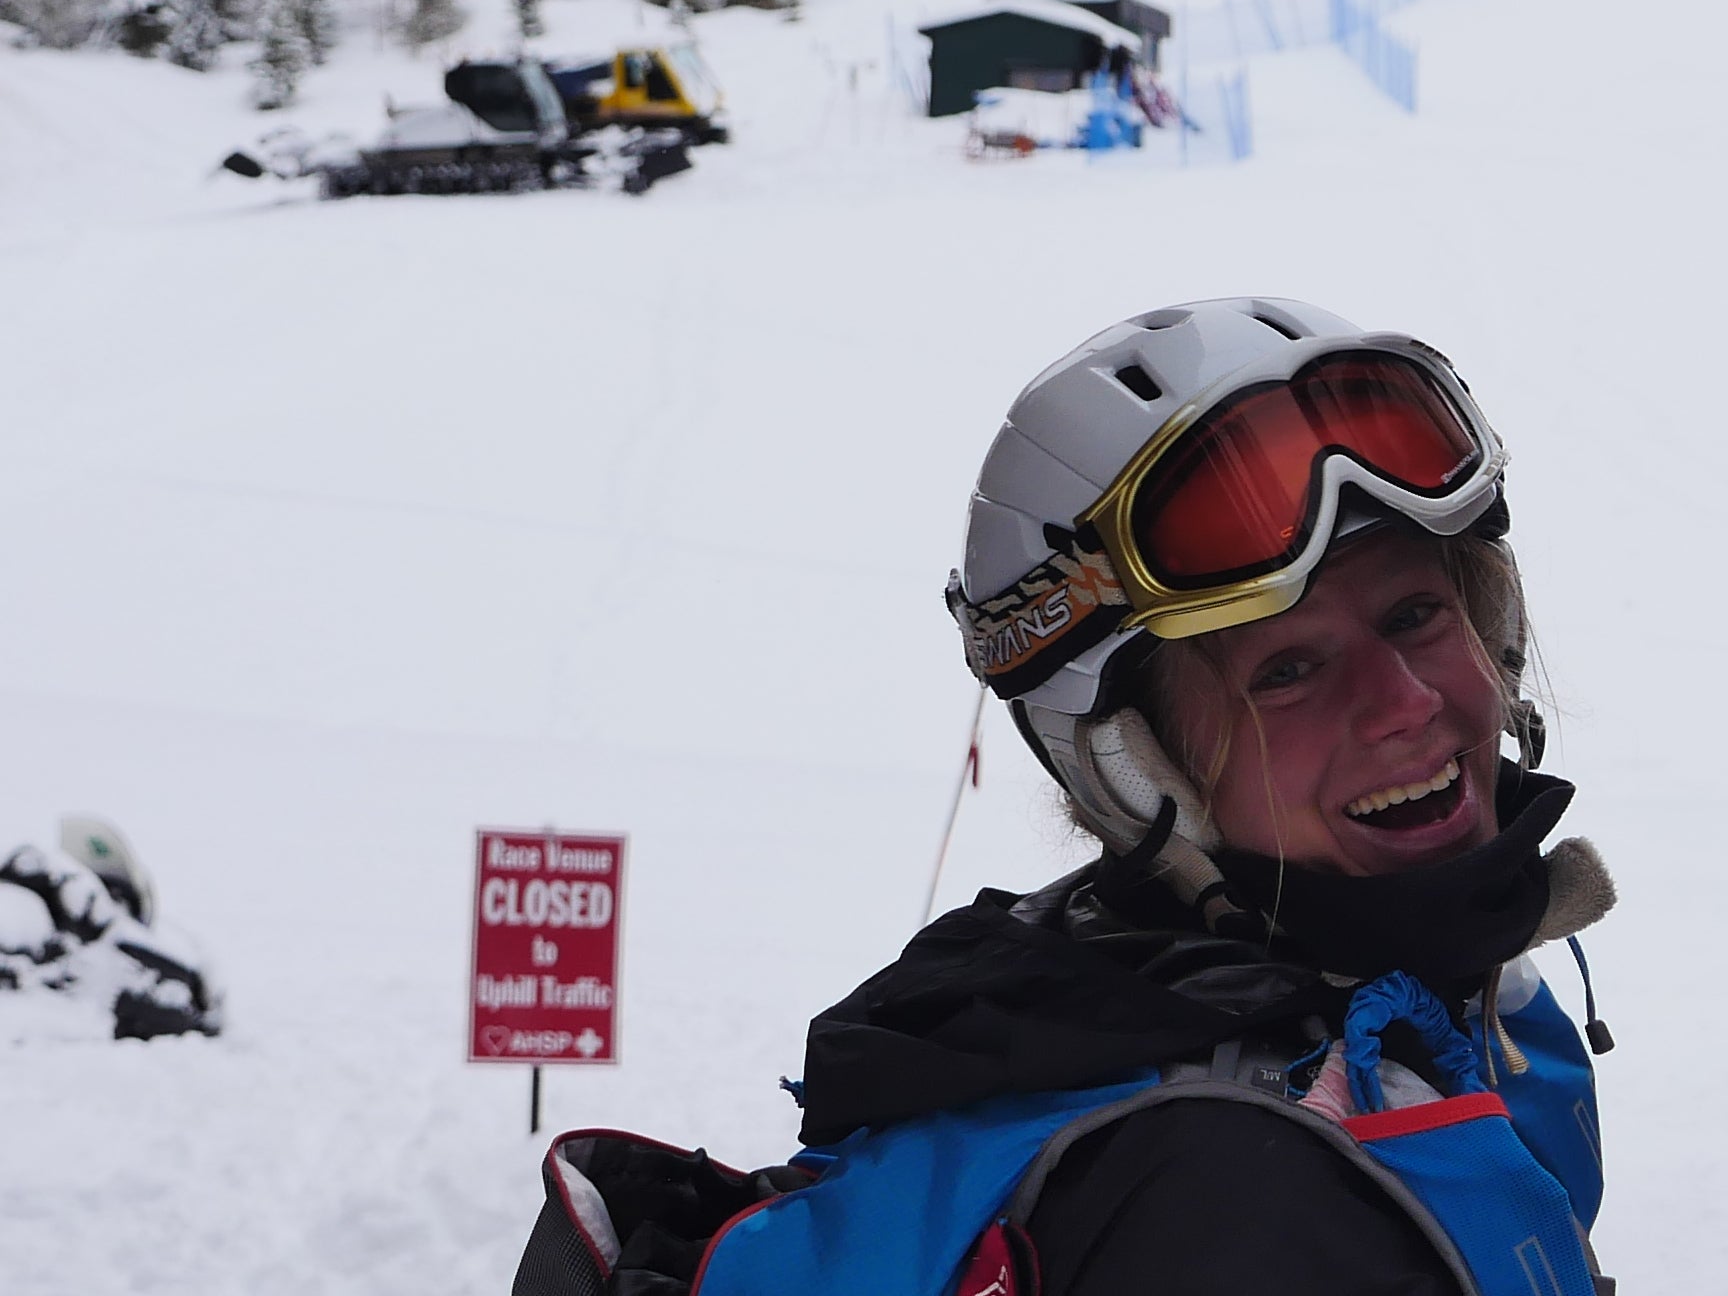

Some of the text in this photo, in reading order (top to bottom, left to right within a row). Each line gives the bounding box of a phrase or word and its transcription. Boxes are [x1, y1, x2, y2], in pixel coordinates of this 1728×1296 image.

[487, 837, 613, 874] Race Venue
[482, 876, 614, 929] CLOSED
[532, 933, 558, 967] to
[477, 974, 612, 1011] Uphill Traffic
